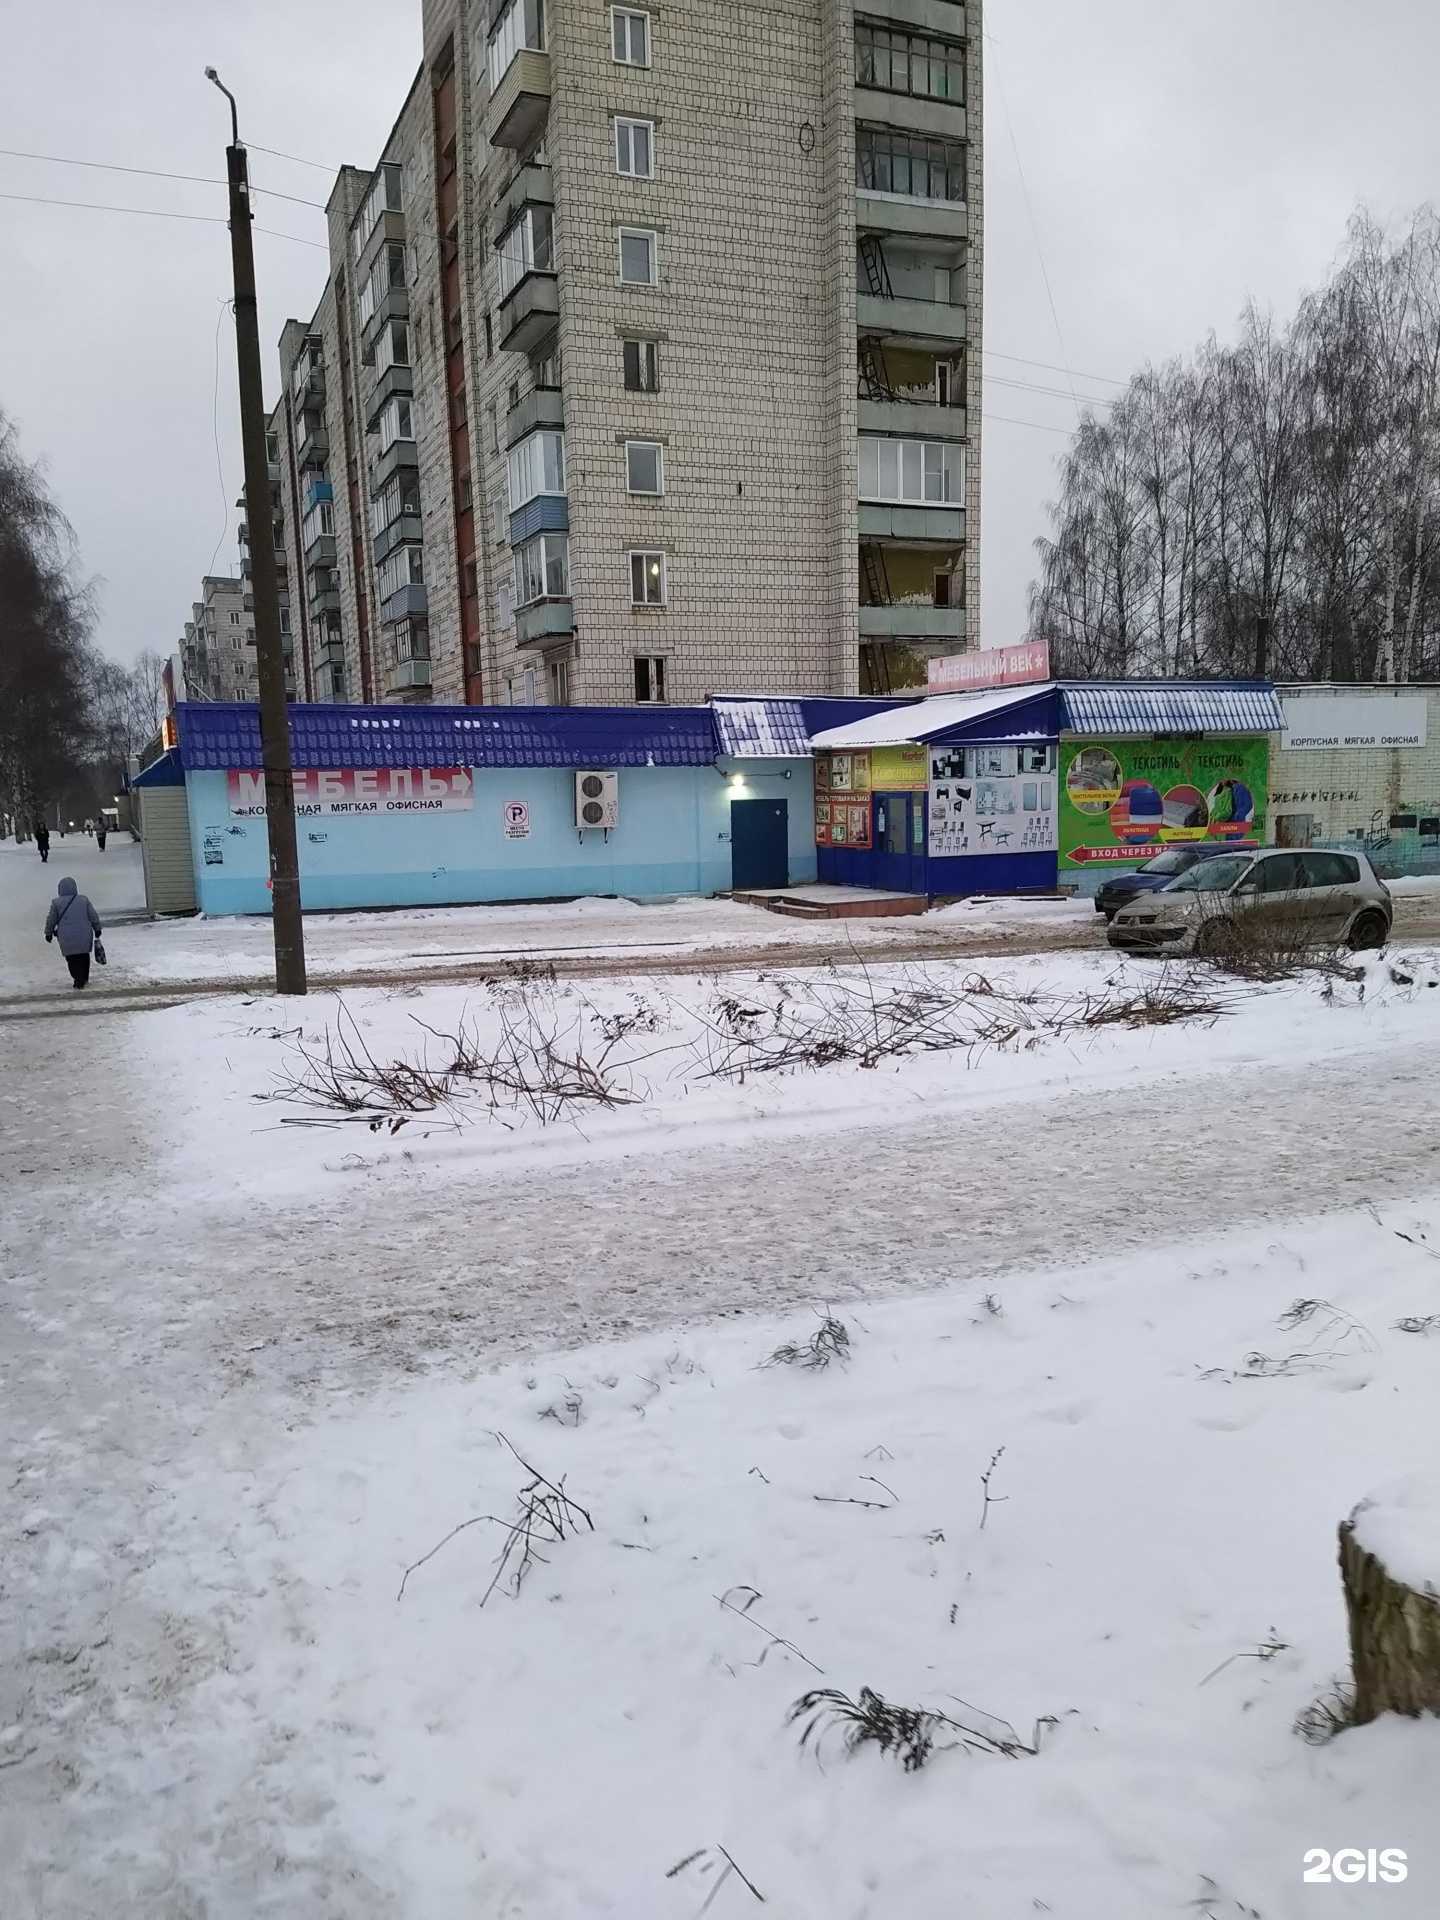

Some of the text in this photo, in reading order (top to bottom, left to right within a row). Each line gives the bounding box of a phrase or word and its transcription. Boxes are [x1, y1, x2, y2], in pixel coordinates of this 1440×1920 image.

[940, 653, 1032, 683] МЕБЕЛЬНЫЙ ВЕК
[1290, 735, 1419, 747] КОРПУСНАЯ МЯГКАЯ ОФИСНАЯ
[1132, 753, 1244, 770] ТЕКСТИЛЬ ТЕКСТИЛЬ
[238, 769, 448, 801] МЕБЕЛЬ
[248, 800, 443, 816] КОНАЯ МЯГКАЯ ОФИСНАЯ
[1091, 849, 1119, 857] ВХОД
[1121, 847, 1152, 856] ЧЕРЕЗ
